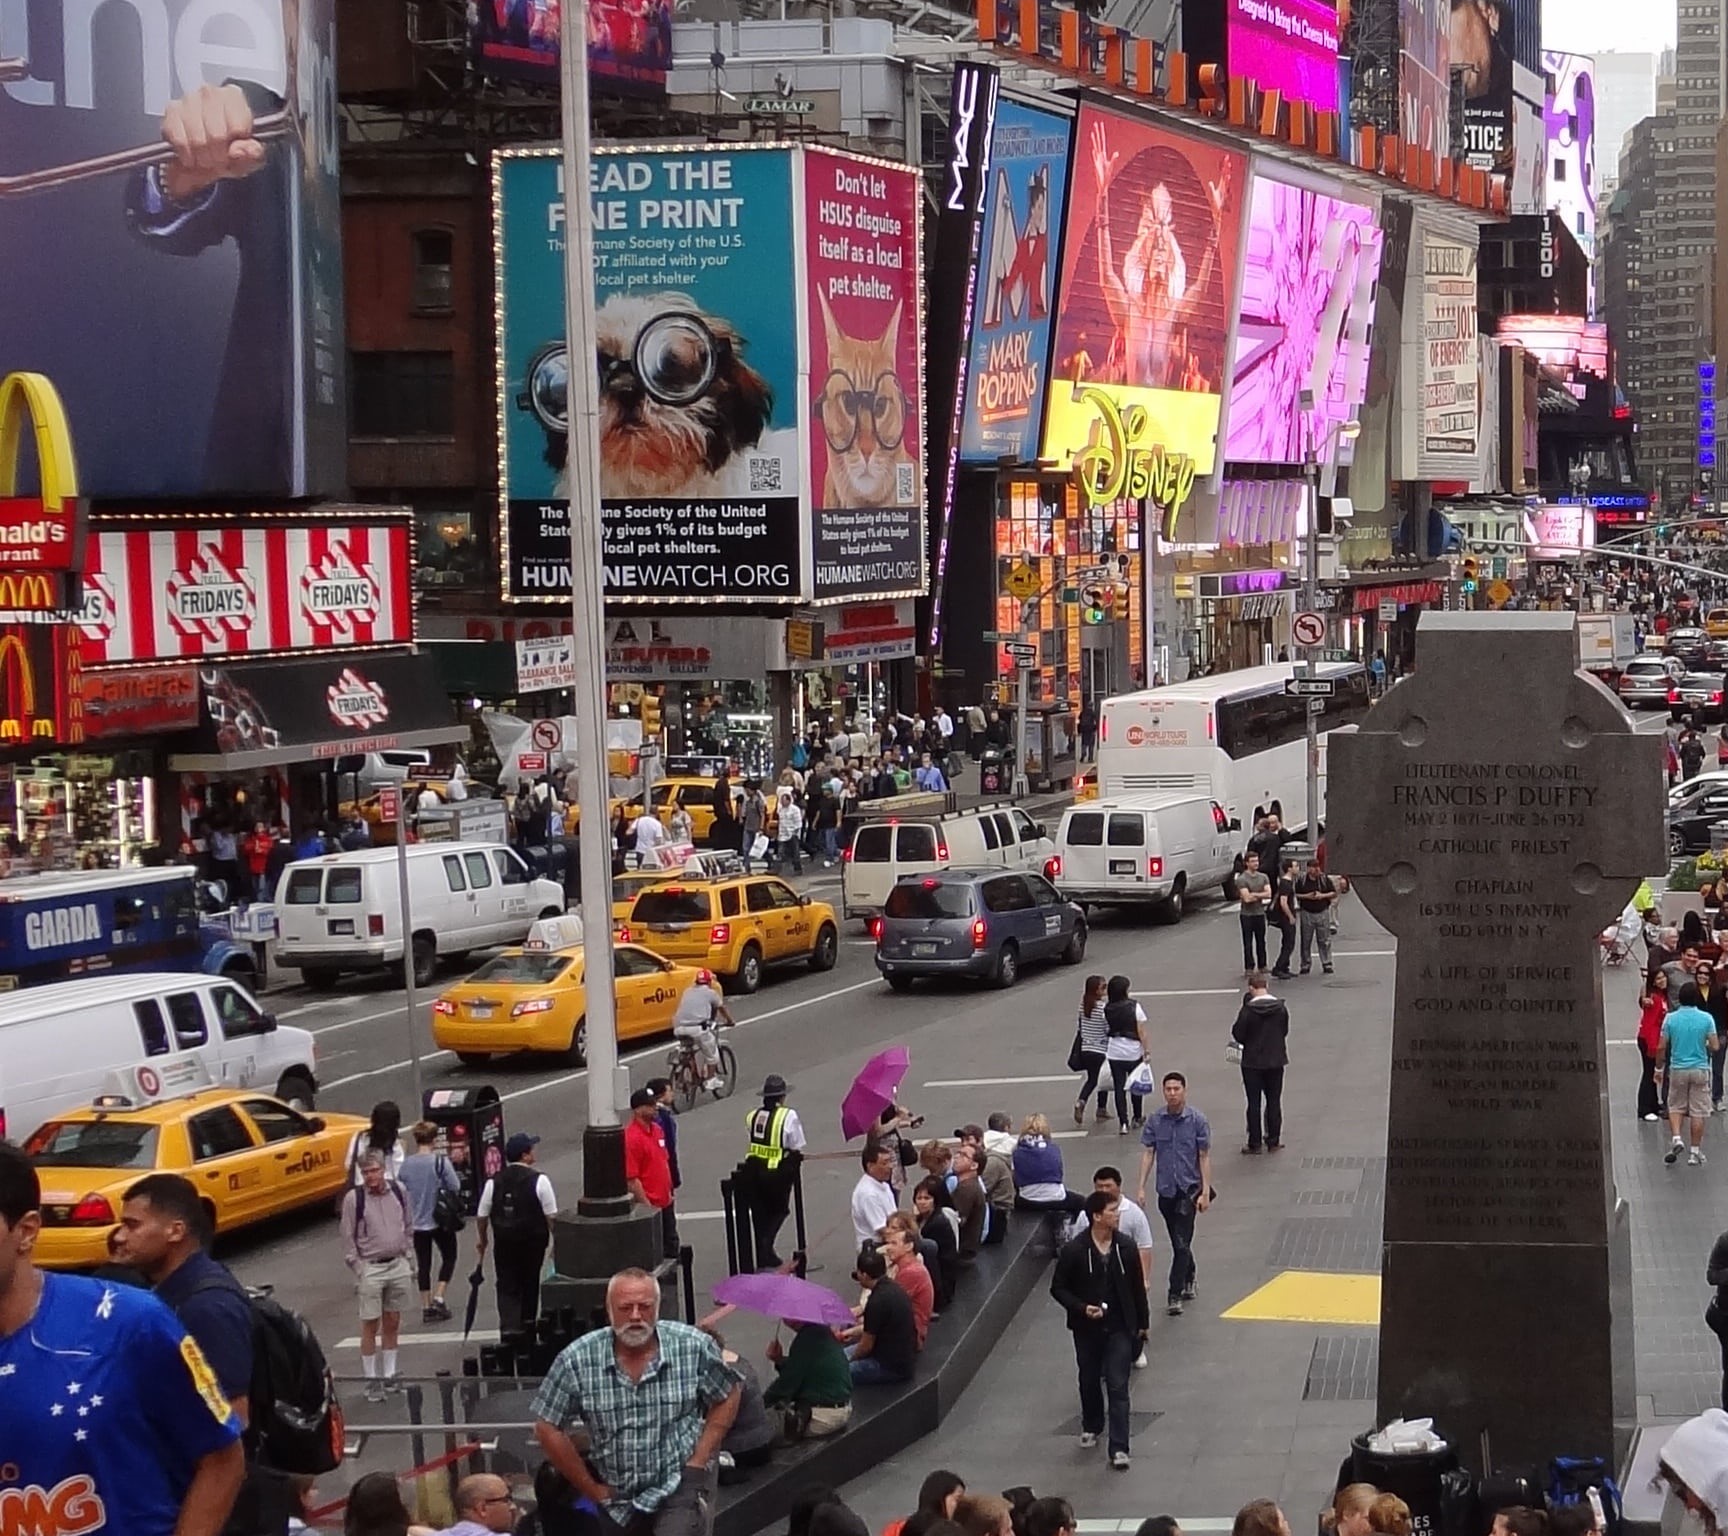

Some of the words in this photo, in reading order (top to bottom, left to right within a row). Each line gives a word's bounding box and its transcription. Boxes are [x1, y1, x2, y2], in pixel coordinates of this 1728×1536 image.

[1274, 7, 1291, 36] Bring
[1301, 20, 1323, 47] Cinema
[751, 99, 811, 113] LAMAR
[1463, 124, 1504, 153] STICE
[557, 162, 653, 194] EAD
[662, 159, 733, 191] THE
[835, 168, 868, 196] Don't
[870, 174, 887, 200] let
[547, 202, 628, 232] FNE
[640, 198, 744, 231] PRINT
[819, 200, 853, 227] HSUS
[855, 206, 902, 238] disguise
[629, 236, 676, 252] Society
[679, 237, 695, 249] of
[696, 235, 717, 249] the
[720, 234, 746, 248] U.S.
[819, 234, 849, 261] itself
[851, 244, 865, 263] as
[867, 250, 874, 265] a
[876, 242, 903, 269] local
[612, 254, 666, 268] affiliated
[669, 254, 698, 267] with
[700, 255, 729, 270] your
[596, 272, 624, 285] local
[628, 272, 650, 290] pet
[652, 270, 699, 285] shelter.
[829, 275, 850, 299] pet
[851, 273, 894, 301] shelter.
[989, 331, 1033, 373] MARY
[977, 362, 1039, 411] POPPINS
[539, 506, 564, 520] The
[624, 505, 674, 520] Society
[677, 504, 693, 518] of
[694, 504, 718, 518] the
[721, 504, 766, 518] United
[833, 514, 855, 525] Humane
[855, 513, 875, 526] Society
[616, 524, 652, 540] gives
[655, 523, 676, 536] 1%
[679, 523, 695, 536] of
[697, 523, 715, 536] its
[717, 523, 767, 539] budget
[603, 541, 635, 555] local
[637, 541, 660, 557] pet
[663, 541, 721, 555] shelters.
[522, 564, 790, 588] HUMNEWATCH.ORG
[816, 560, 917, 585] HUMANEWATCH.ORG
[518, 666, 558, 680] CLEARANCE
[1405, 764, 1500, 779] LIEUTENANT
[1504, 764, 1579, 780] COLONEL
[1392, 785, 1488, 806] FRANCIS
[1496, 786, 1508, 806] P
[1518, 786, 1599, 807] DUFFY
[1404, 813, 1433, 826] MAY
[1532, 813, 1549, 826] 26
[1553, 813, 1585, 827] 1932
[1418, 838, 1502, 854] CATHOLIC
[1511, 839, 1571, 855] PRIEST
[1454, 880, 1535, 895] CHAPLAIN
[1419, 903, 1462, 917] 165TH
[1500, 903, 1571, 919] INFANTRY
[25, 903, 103, 950] GARDA
[1439, 924, 1472, 937] OLD
[1518, 924, 1529, 937] N
[1419, 966, 1434, 980] A
[1439, 966, 1471, 980] LIFE
[1477, 966, 1499, 980] OF
[1505, 966, 1572, 981] SERVICE
[1480, 982, 1508, 995] FOR
[1413, 998, 1452, 1012] GOD
[1458, 998, 1493, 1011] AND
[1499, 998, 1577, 1013] COUNTRY
